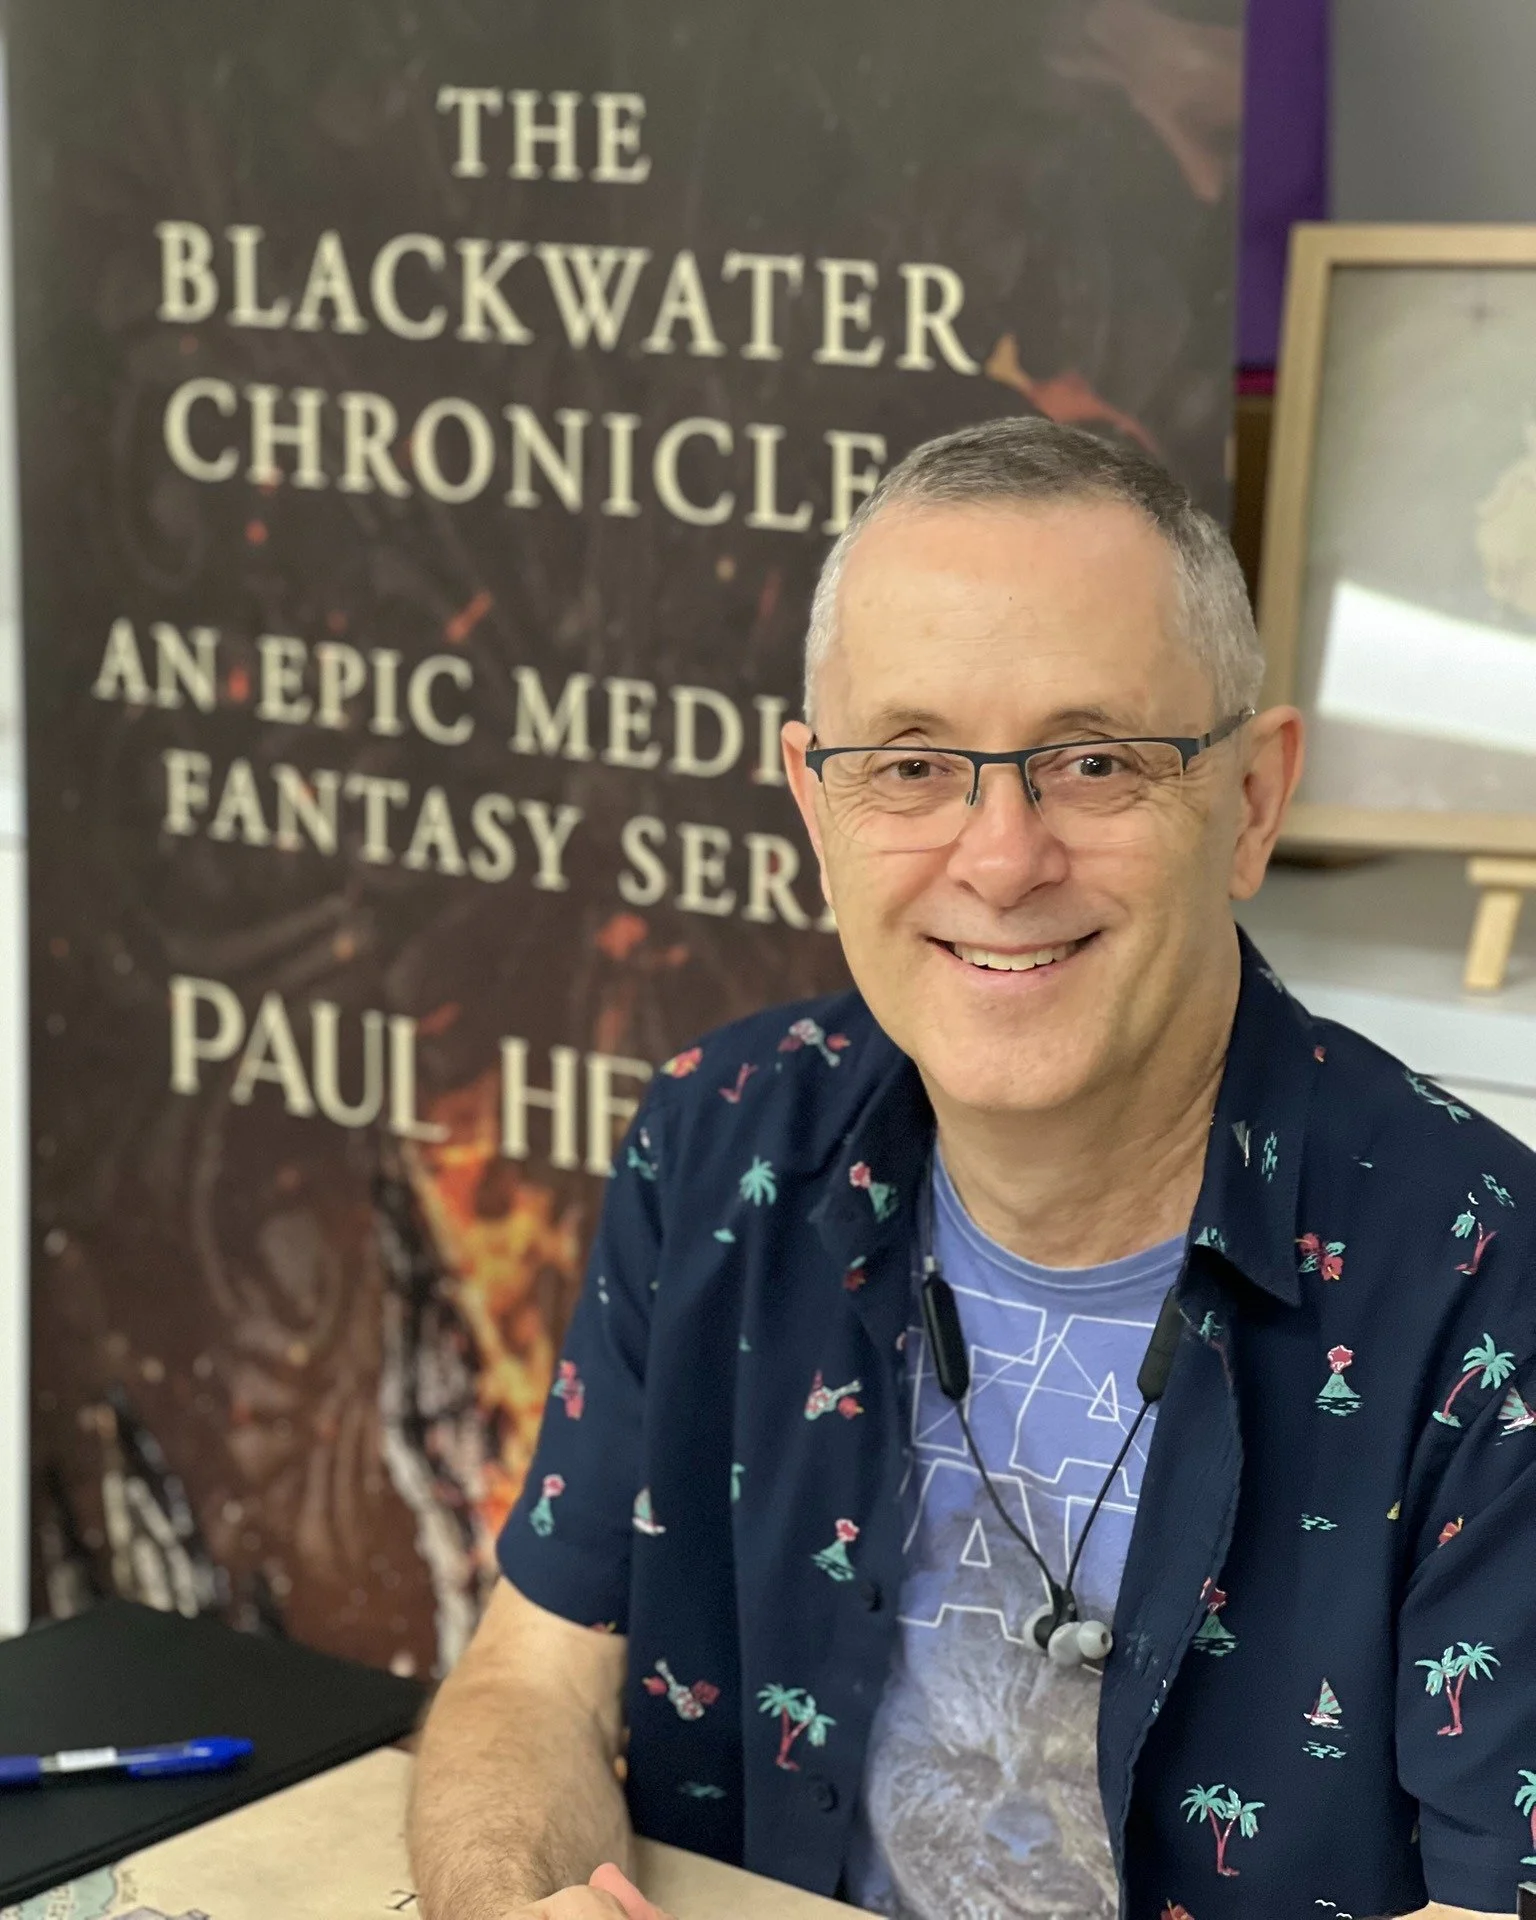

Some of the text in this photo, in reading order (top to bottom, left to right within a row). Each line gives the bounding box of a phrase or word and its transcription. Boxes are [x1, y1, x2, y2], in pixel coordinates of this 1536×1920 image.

[437, 85, 651, 184] THE
[154, 220, 979, 375] BLACKWATER
[92, 616, 788, 787] AN EPIC MEDI
[162, 747, 838, 934] FANTASY SER
[168, 974, 451, 1142] PAUL
